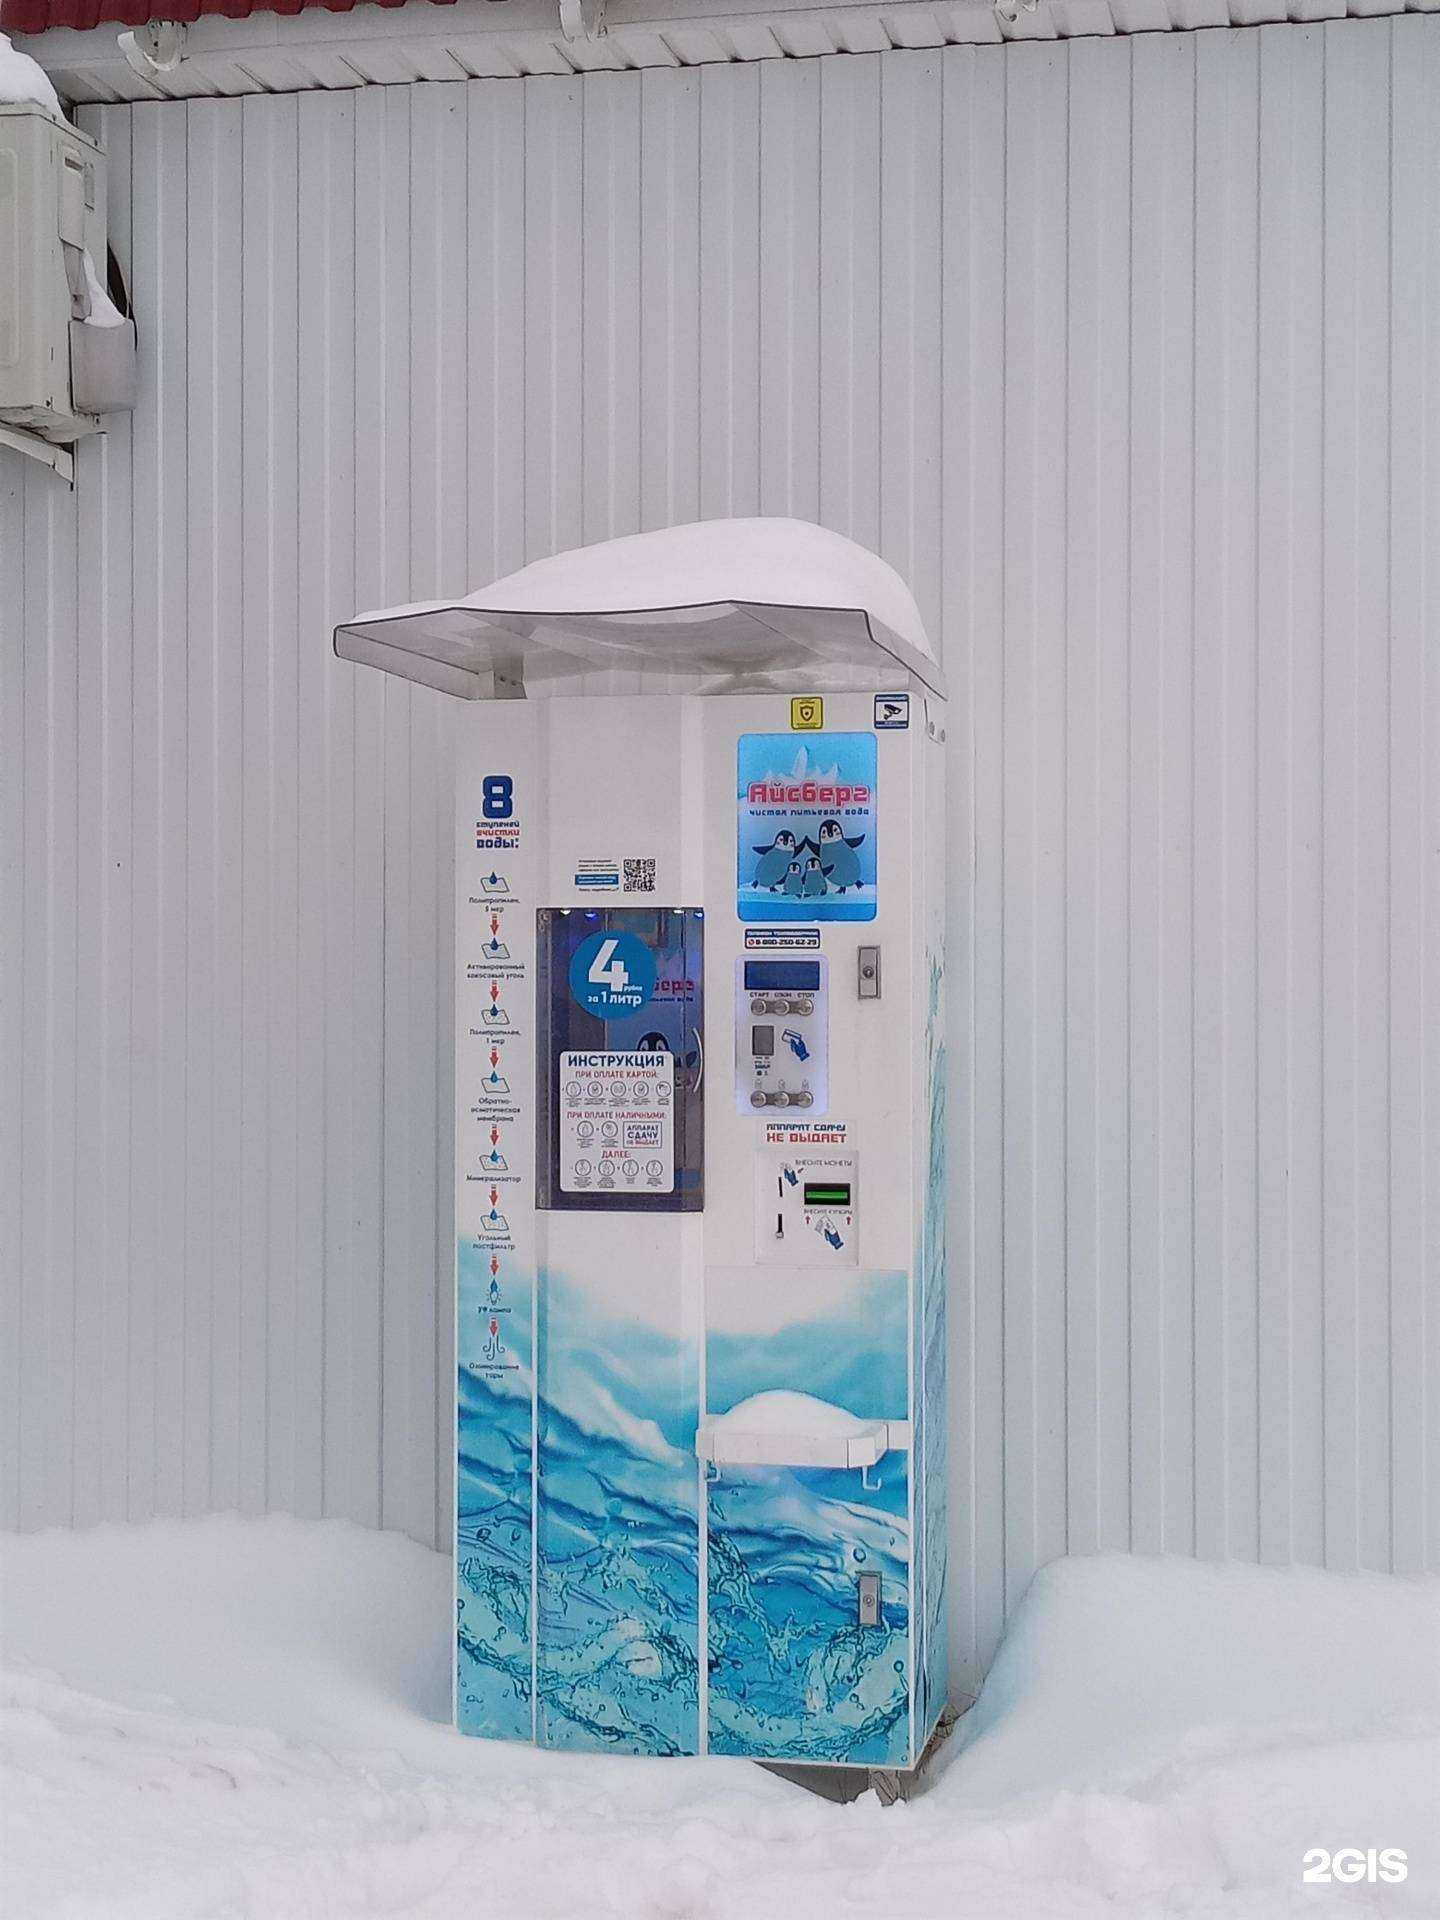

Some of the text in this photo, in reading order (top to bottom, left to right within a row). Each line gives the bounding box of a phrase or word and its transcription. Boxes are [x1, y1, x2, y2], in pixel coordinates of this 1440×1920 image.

[482, 775, 513, 819] 8
[747, 781, 871, 808] Айсберг
[749, 808, 870, 817] чистая питьевая вода
[476, 820, 520, 829] ступеней
[476, 837, 520, 849] воды:
[588, 939, 629, 992] 4
[587, 995, 599, 1003] за
[601, 991, 607, 1003] 1
[609, 994, 642, 1007] литр
[568, 1054, 665, 1069] ИНСТРУКЦИЯ
[575, 1070, 592, 1079] ПРИ
[594, 1070, 625, 1079] ОПЛАТЕ
[567, 1111, 582, 1119] ПРИ
[584, 1111, 613, 1119] ОПЛАТЕ
[626, 1124, 659, 1132] АППАРАТ
[766, 1123, 846, 1132] АППАРАТ СДАЧУ
[627, 1131, 659, 1139] СДАЧУ
[766, 1133, 847, 1143] НЕ ВЫДАЕТ
